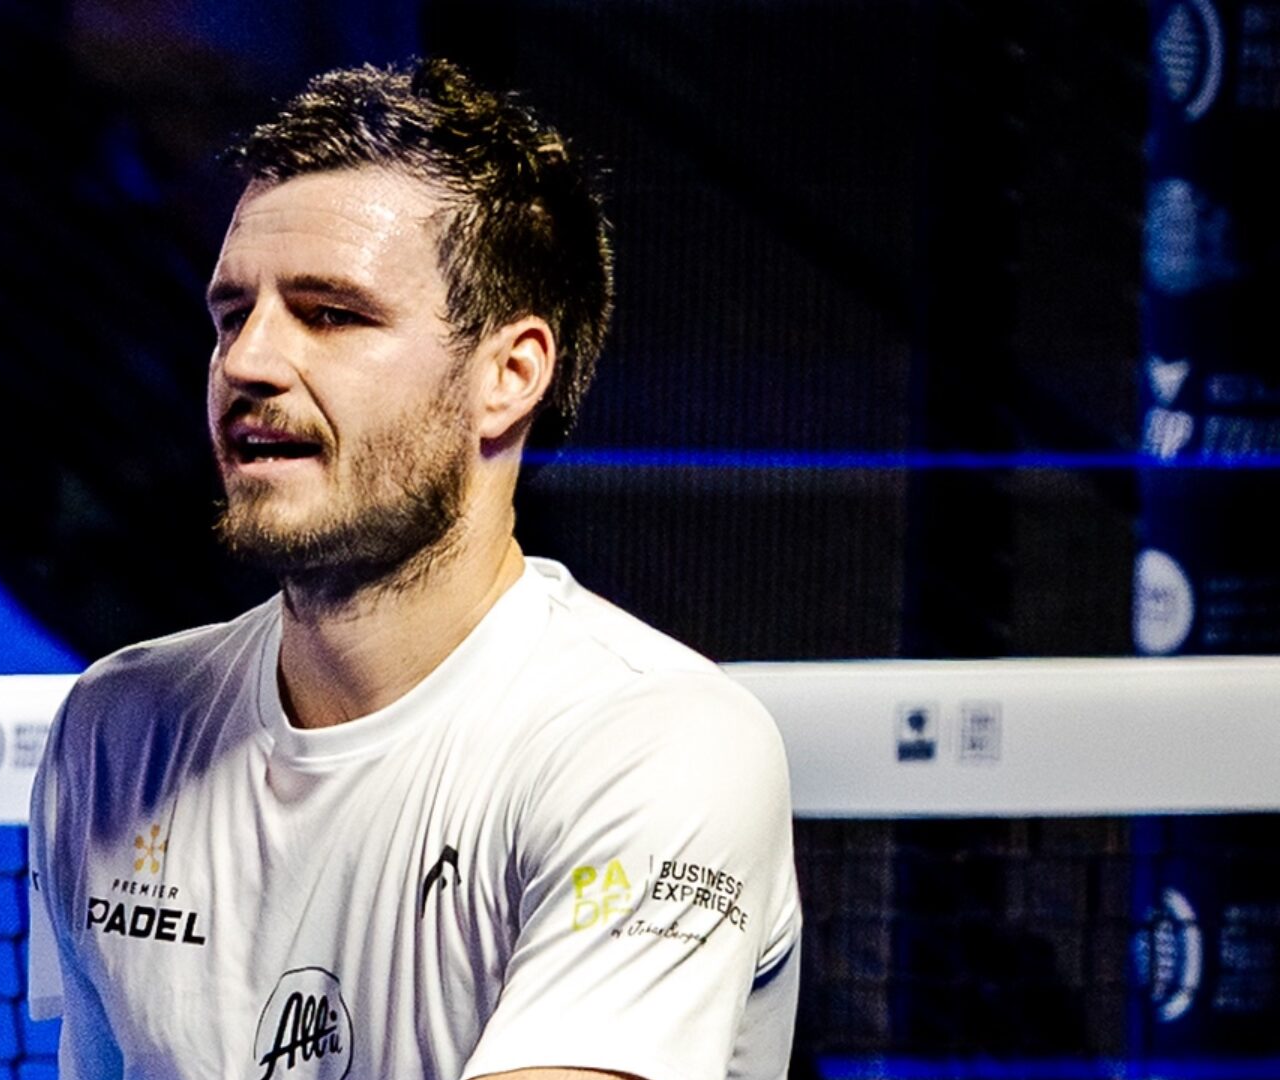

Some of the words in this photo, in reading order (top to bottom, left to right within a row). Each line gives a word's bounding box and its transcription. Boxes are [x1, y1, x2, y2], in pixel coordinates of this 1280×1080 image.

[111, 878, 179, 900] PREMIER
[660, 861, 744, 900] BUSINESS
[86, 897, 206, 946] PADEL
